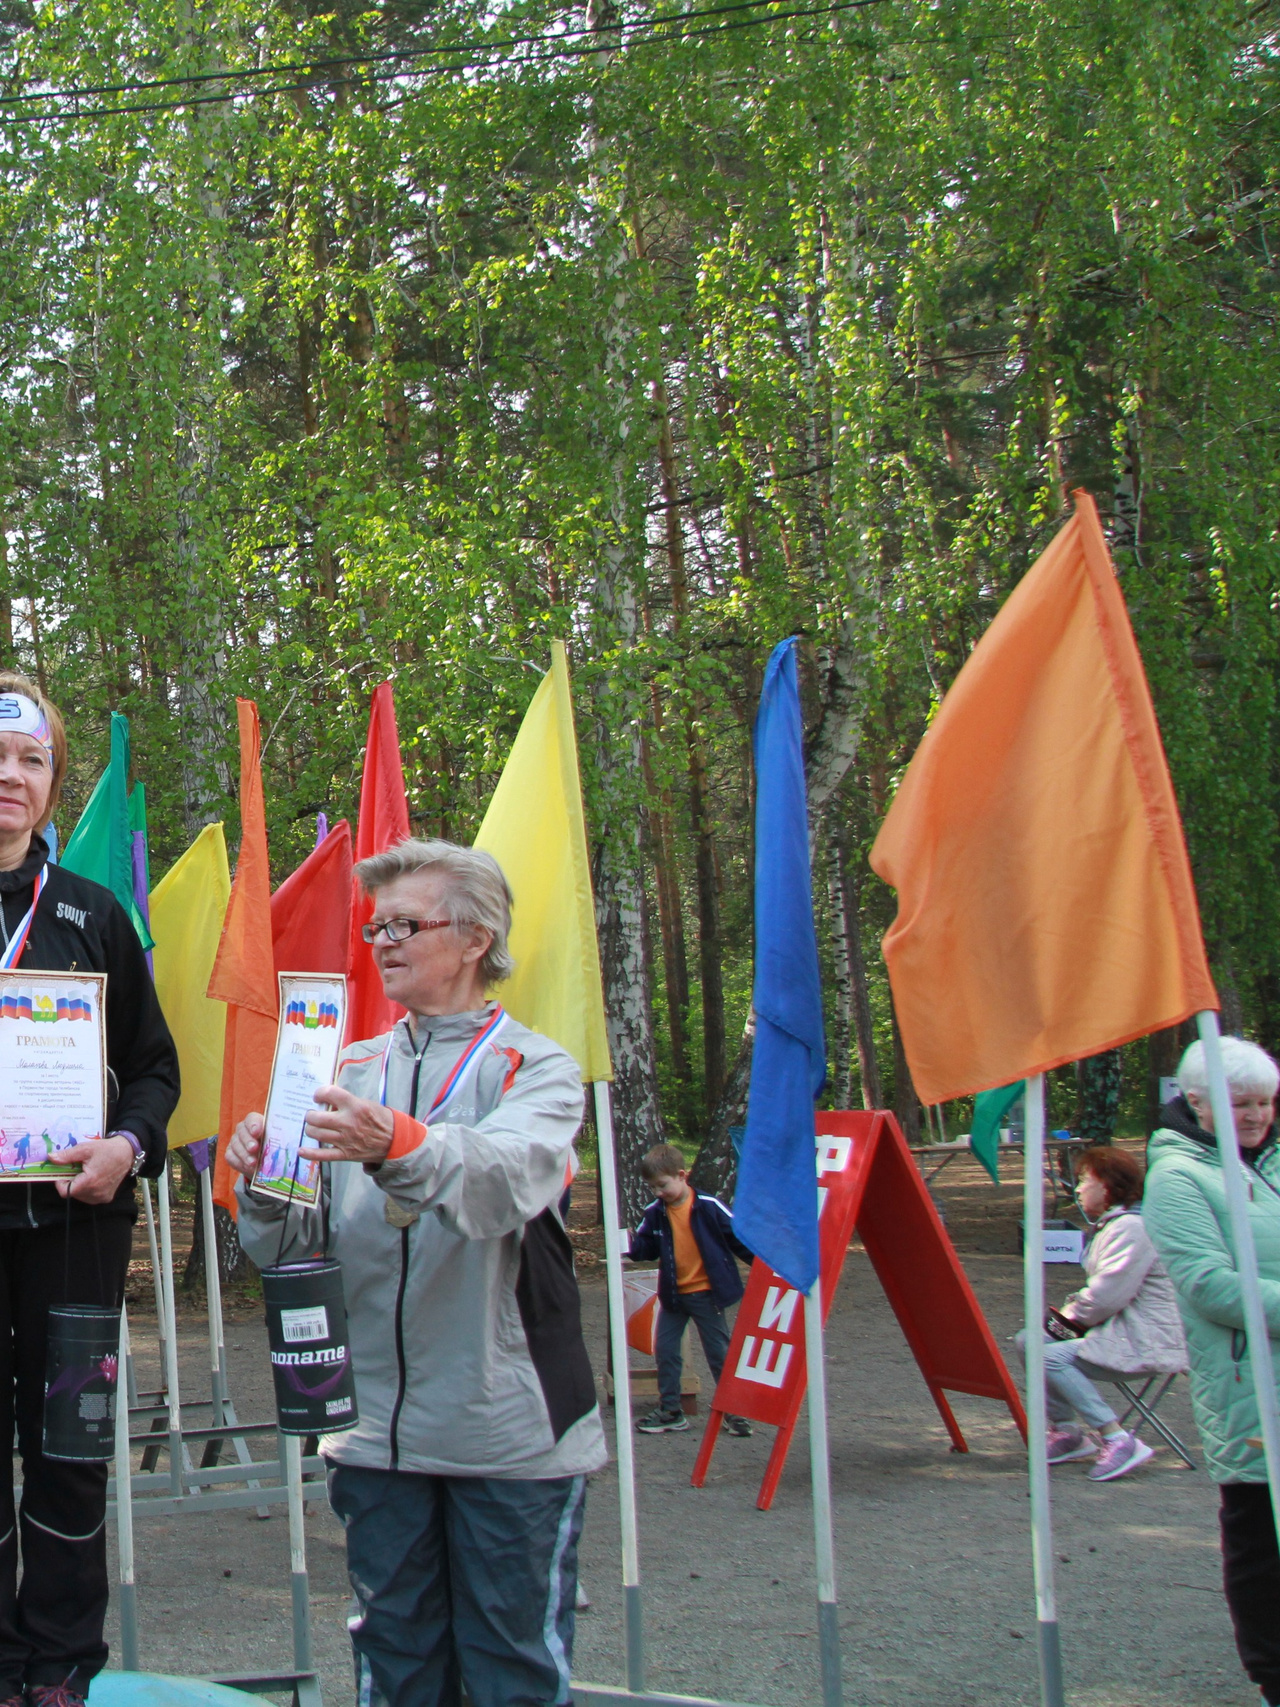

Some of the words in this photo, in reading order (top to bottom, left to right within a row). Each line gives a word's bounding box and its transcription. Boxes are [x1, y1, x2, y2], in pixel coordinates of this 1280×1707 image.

[56, 901, 87, 929] SWIX
[16, 1035, 76, 1048] ГРАМОТА
[734, 1134, 852, 1389] ФИШ
[271, 1345, 345, 1365] noname
